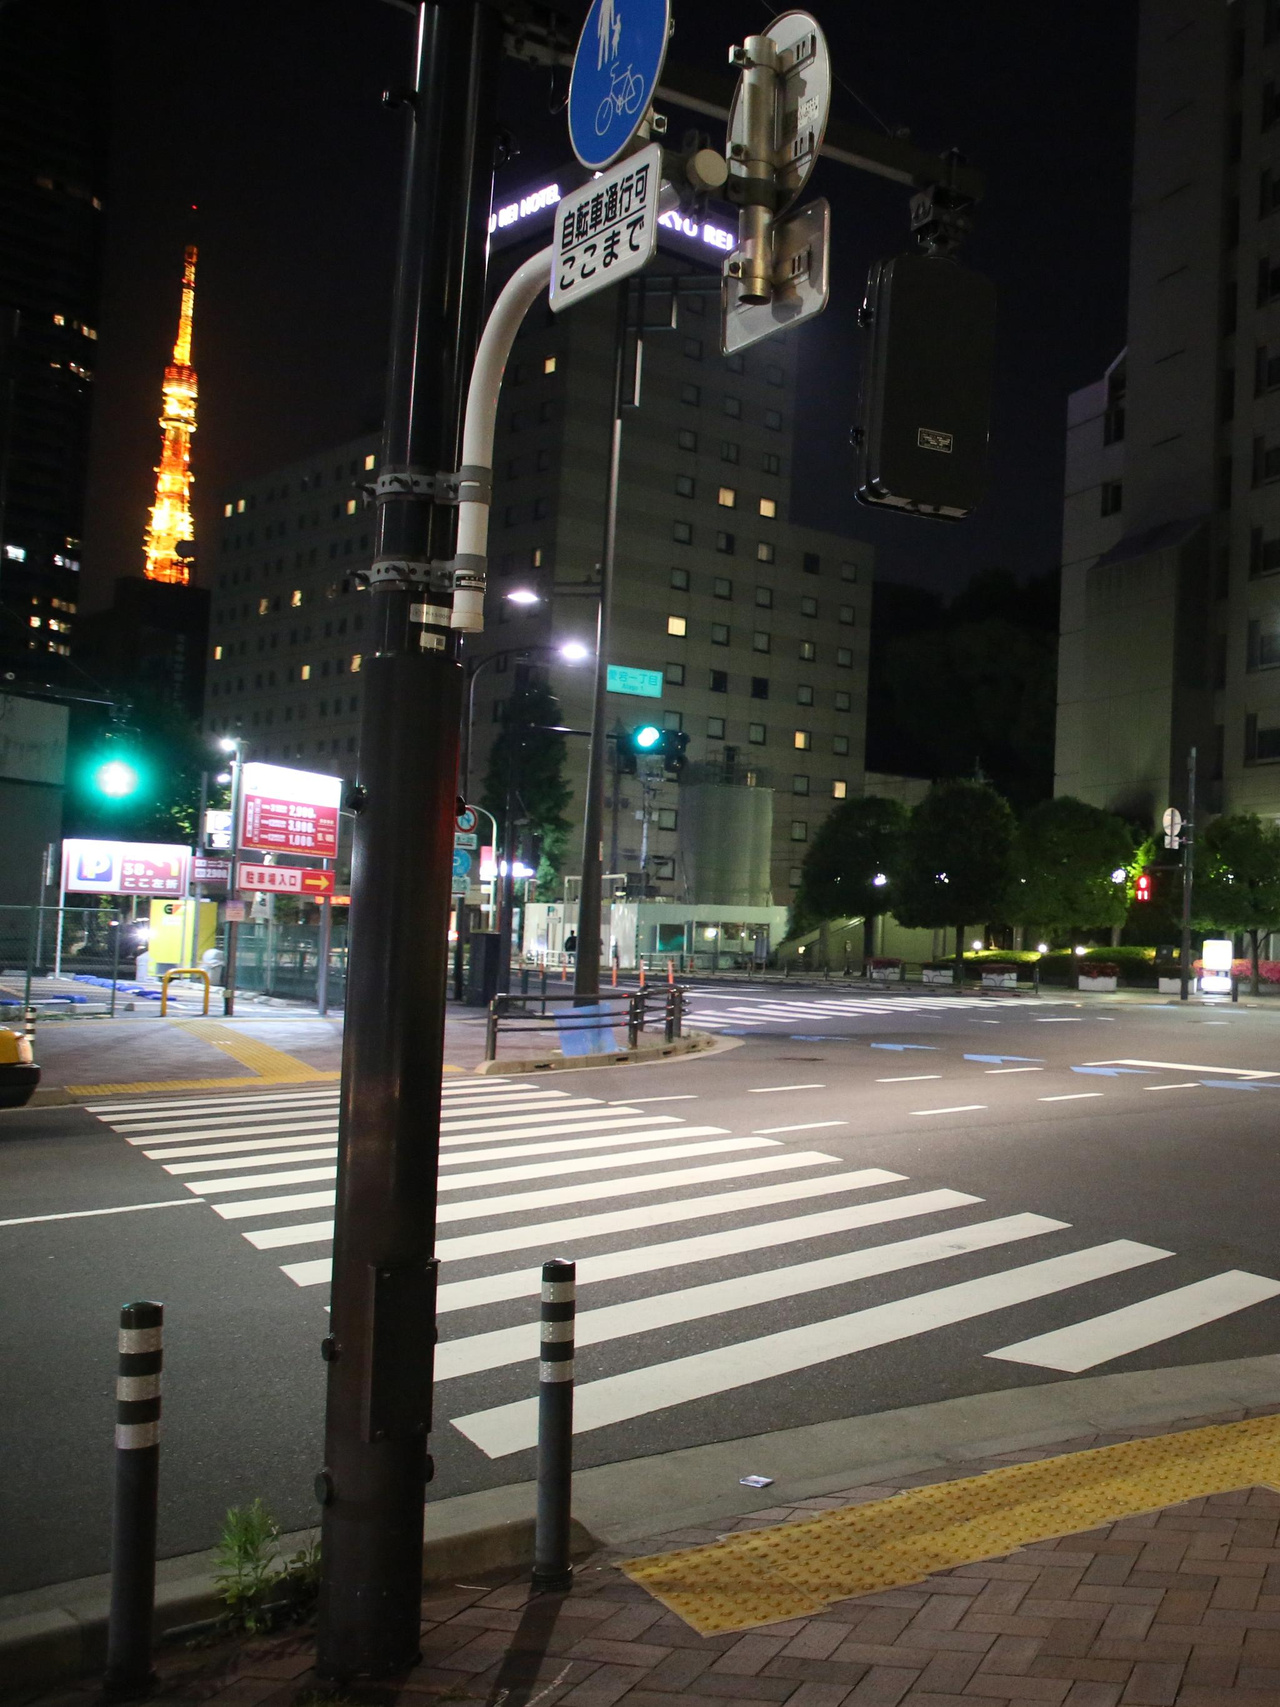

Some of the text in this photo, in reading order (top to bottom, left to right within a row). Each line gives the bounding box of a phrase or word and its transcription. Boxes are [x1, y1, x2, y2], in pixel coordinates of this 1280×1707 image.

[520, 184, 561, 217] HOTEL
[561, 164, 650, 249] 自転車通行可
[703, 224, 733, 250] REI
[560, 215, 644, 290] ここまで
[123, 877, 179, 889] ここ左折
[246, 871, 297, 886] 駐車場入口
